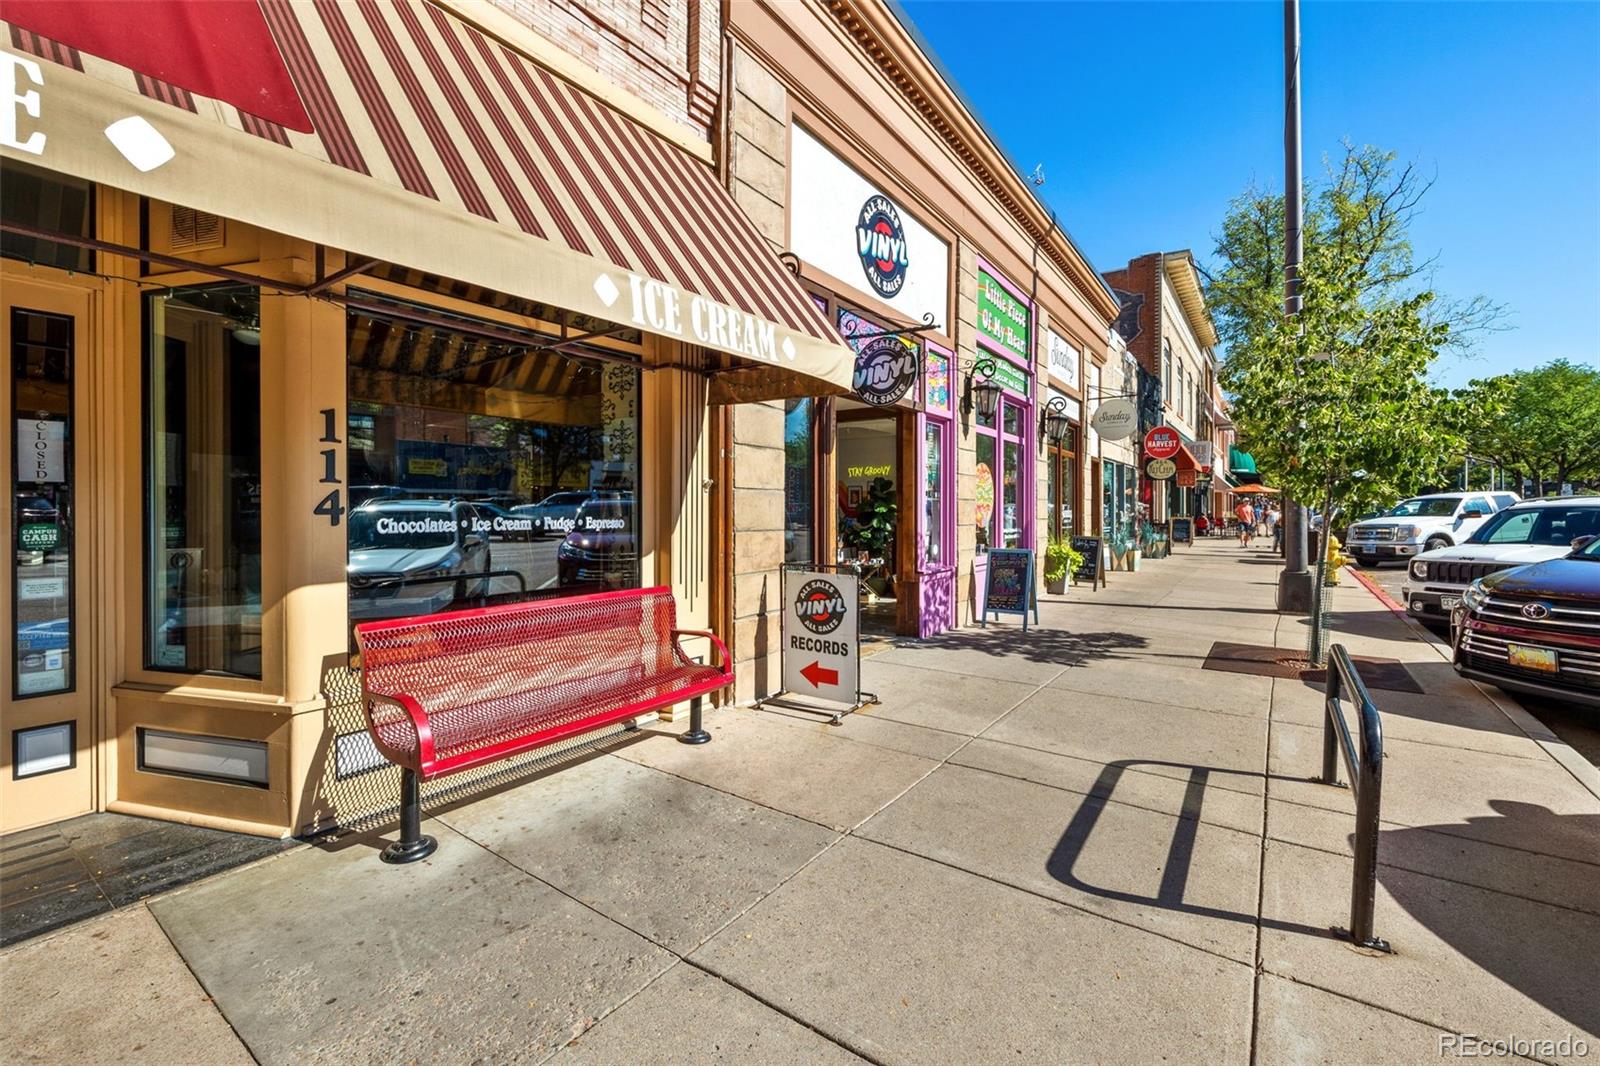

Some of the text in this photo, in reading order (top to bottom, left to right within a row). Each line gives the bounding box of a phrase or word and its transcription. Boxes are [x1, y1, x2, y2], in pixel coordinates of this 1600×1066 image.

[863, 202, 877, 225] ALL
[858, 227, 908, 267] VINYL
[868, 266, 902, 293] ALL SALES
[628, 273, 779, 361] ICE CREAM
[857, 339, 903, 366] ALL SALES
[853, 356, 915, 389] VINYL
[863, 384, 906, 404] ALL SALES
[1099, 410, 1131, 424] Sunday
[35, 421, 48, 479] CLOSED
[1147, 440, 1177, 448] HARVEST
[313, 407, 345, 526] 114
[864, 465, 891, 476] GROOVY
[377, 516, 625, 534] Chocolates Ice Cream Fudge Espresso
[22, 534, 57, 542] CASH
[801, 581, 835, 599] ALL SALES
[795, 598, 847, 616] VINYL
[804, 619, 839, 632] ALL SALES
[791, 635, 849, 657] RECORDS
